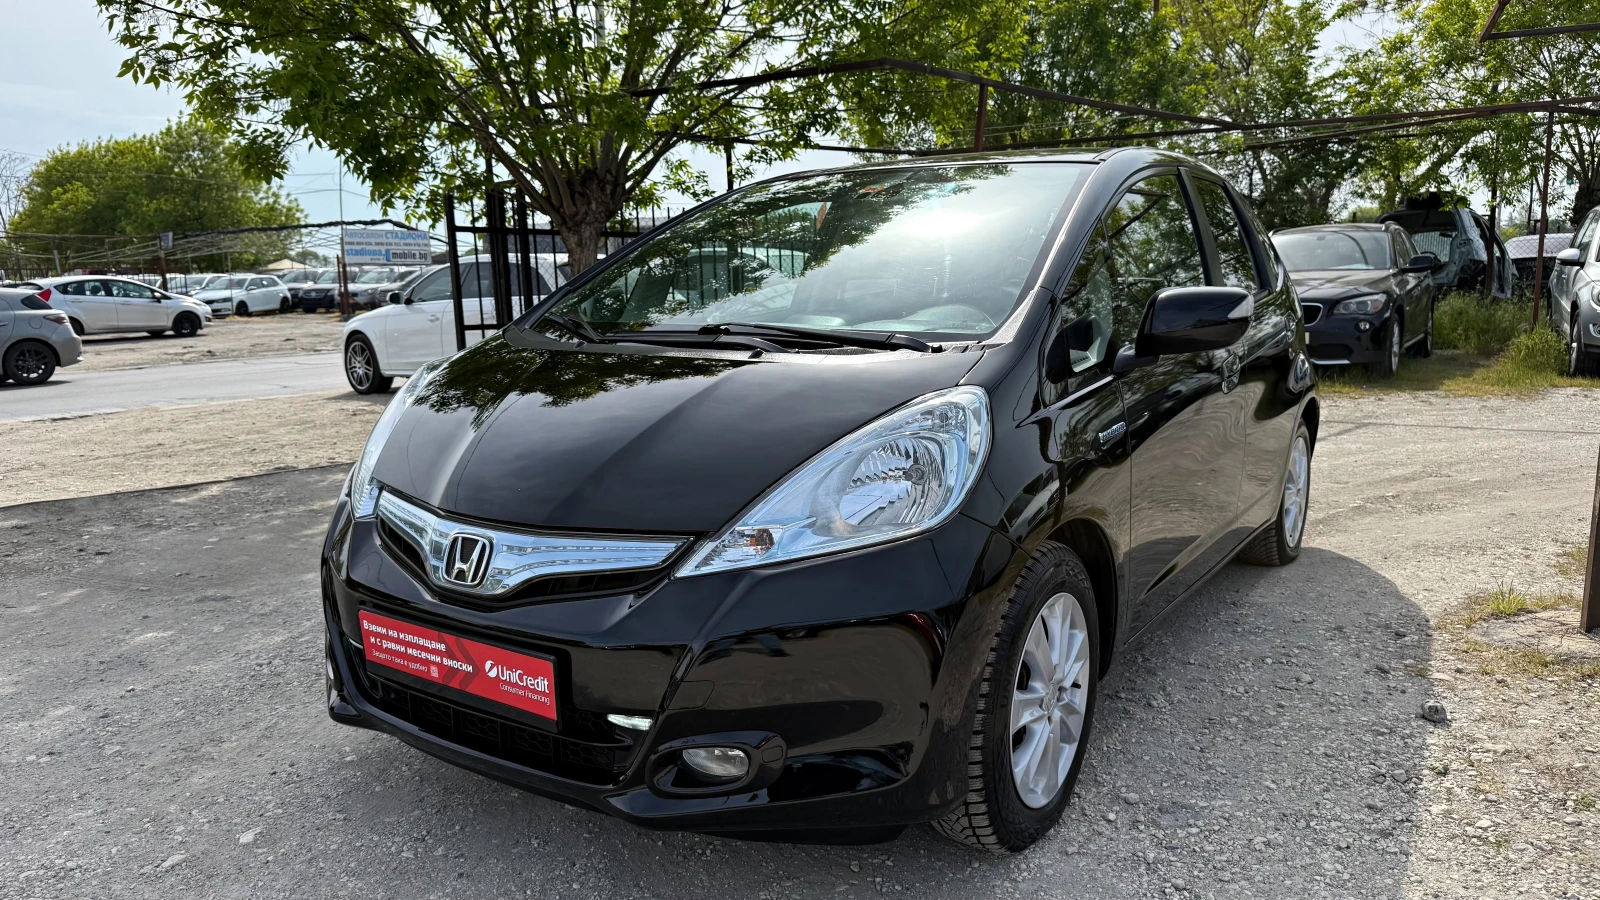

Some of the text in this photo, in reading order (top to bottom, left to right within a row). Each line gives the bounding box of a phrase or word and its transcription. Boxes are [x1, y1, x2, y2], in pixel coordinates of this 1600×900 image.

[344, 230, 428, 241] Автосалон СТАДИОНА
[391, 251, 428, 260] mobile.bg
[363, 620, 446, 651] Вземи на изплащане
[370, 636, 376, 644] и
[382, 640, 406, 653] равни
[407, 646, 441, 663] месечни
[442, 657, 473, 673] вноски
[392, 655, 404, 665] така
[498, 664, 549, 693] UniCredit
[499, 683, 550, 706] Consumer Financing
